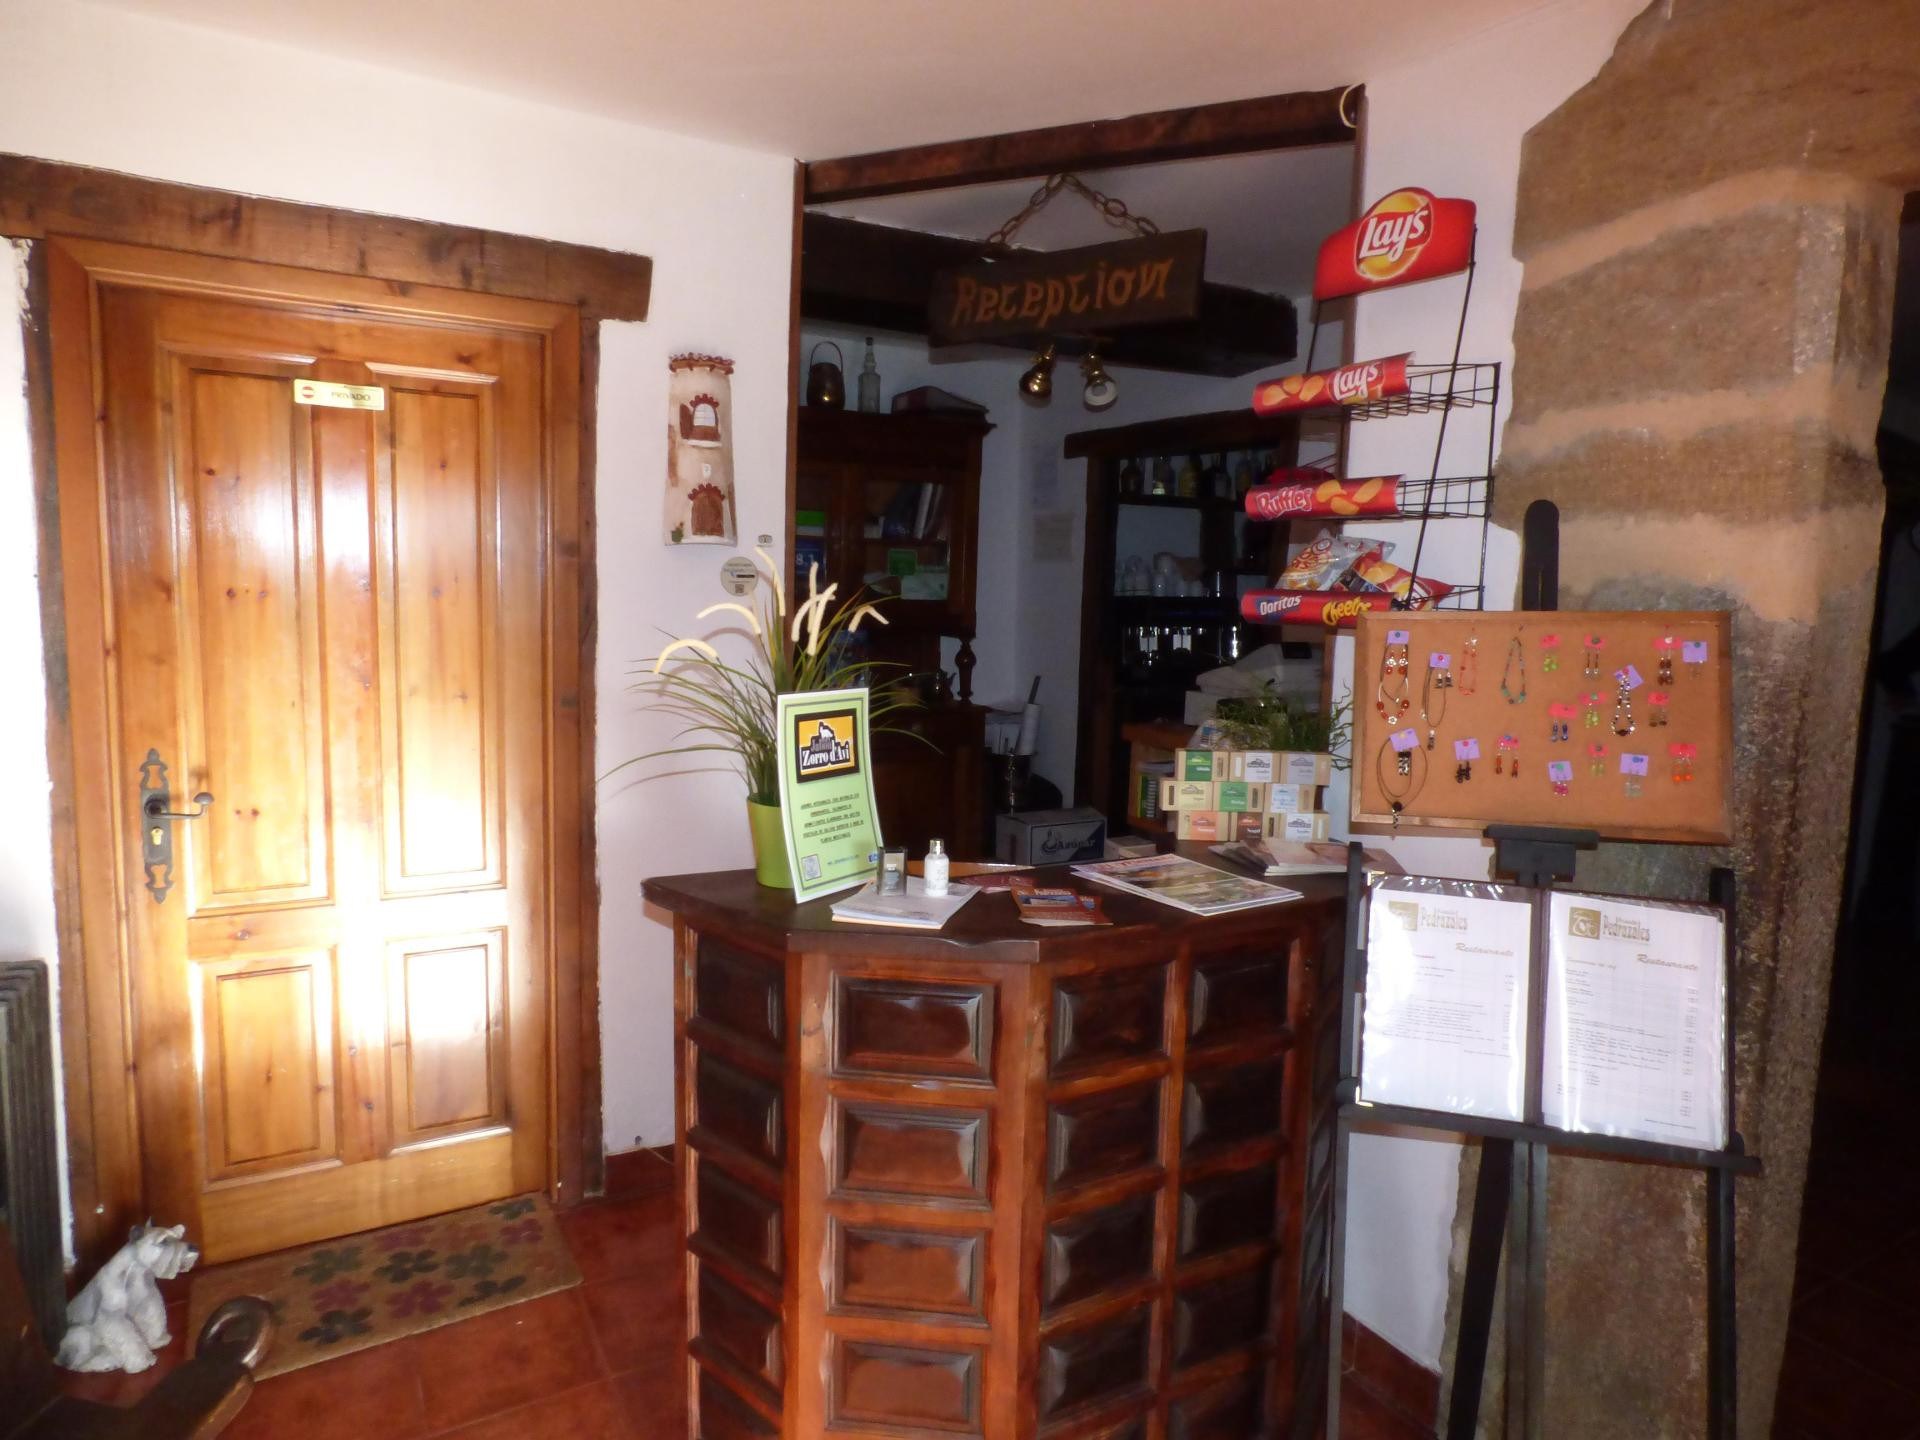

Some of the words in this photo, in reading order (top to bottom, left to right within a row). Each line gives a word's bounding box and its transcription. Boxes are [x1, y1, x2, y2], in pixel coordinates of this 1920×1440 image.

[1359, 206, 1429, 262] Lay's
[1333, 360, 1381, 401] Lay's
[1256, 485, 1313, 518] Ruffles
[1260, 594, 1302, 616] Doritos
[802, 750, 828, 766] Zorro
